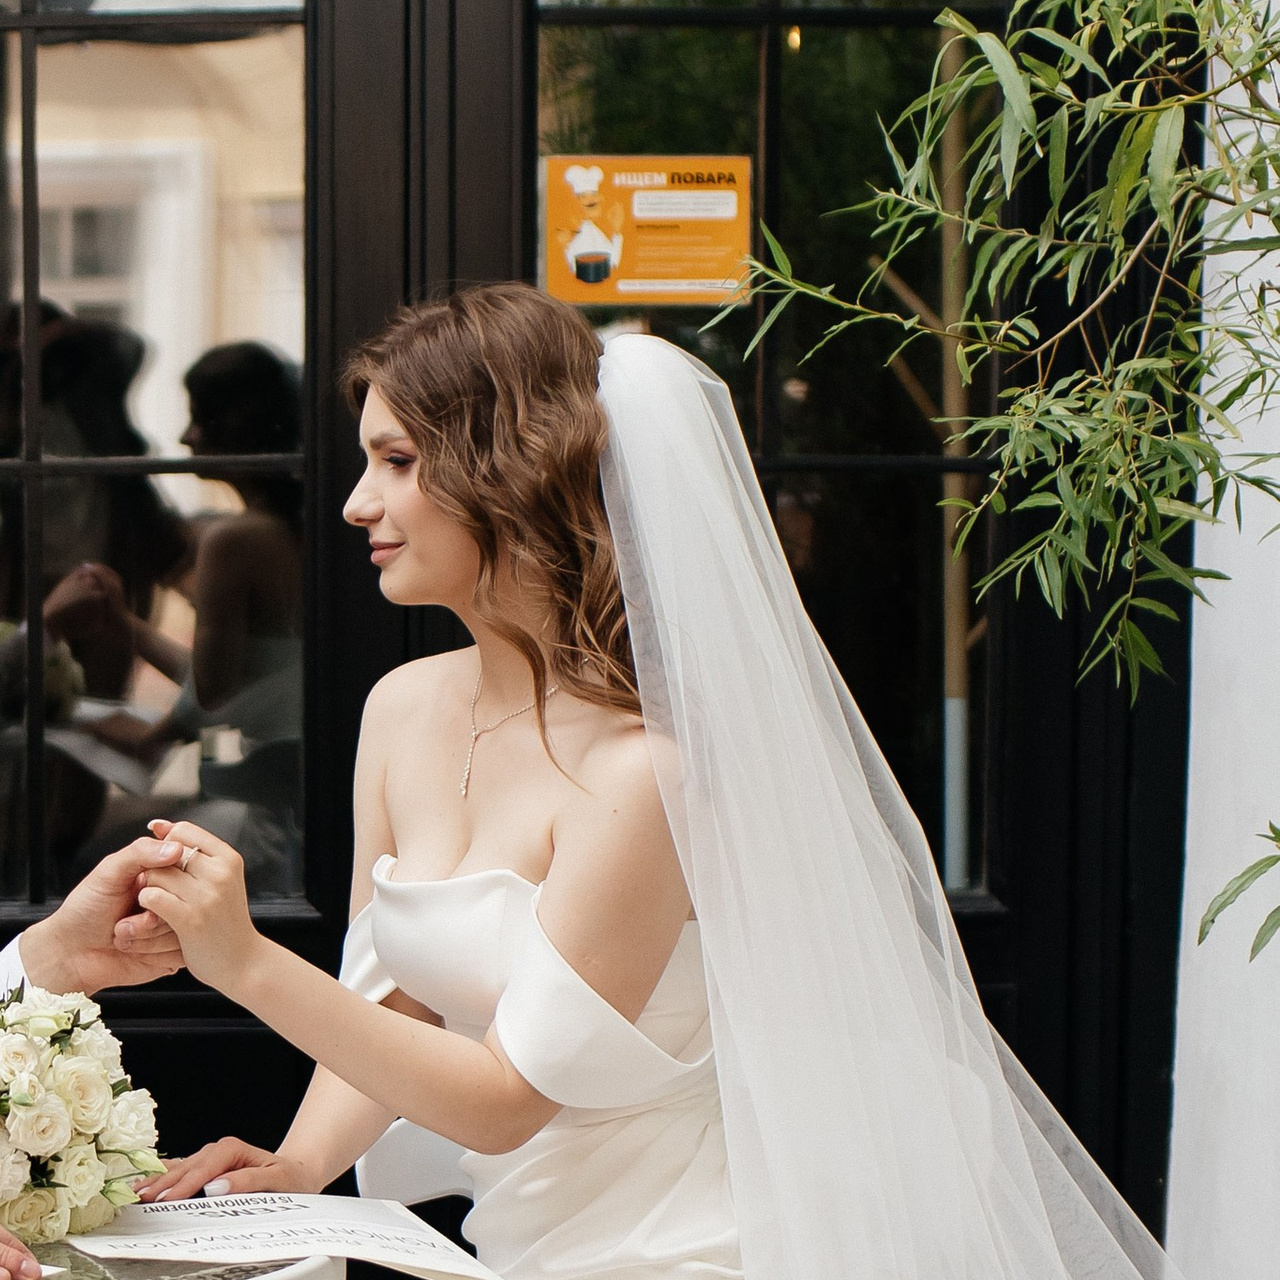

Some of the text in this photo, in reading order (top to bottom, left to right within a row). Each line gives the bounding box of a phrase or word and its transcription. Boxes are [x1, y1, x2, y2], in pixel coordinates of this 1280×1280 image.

[612, 171, 737, 188] ИЩЕМ ПОВАРА
[142, 1195, 294, 1214] IS FASHION MODERN?
[108, 1227, 322, 1250] INFORMATION
